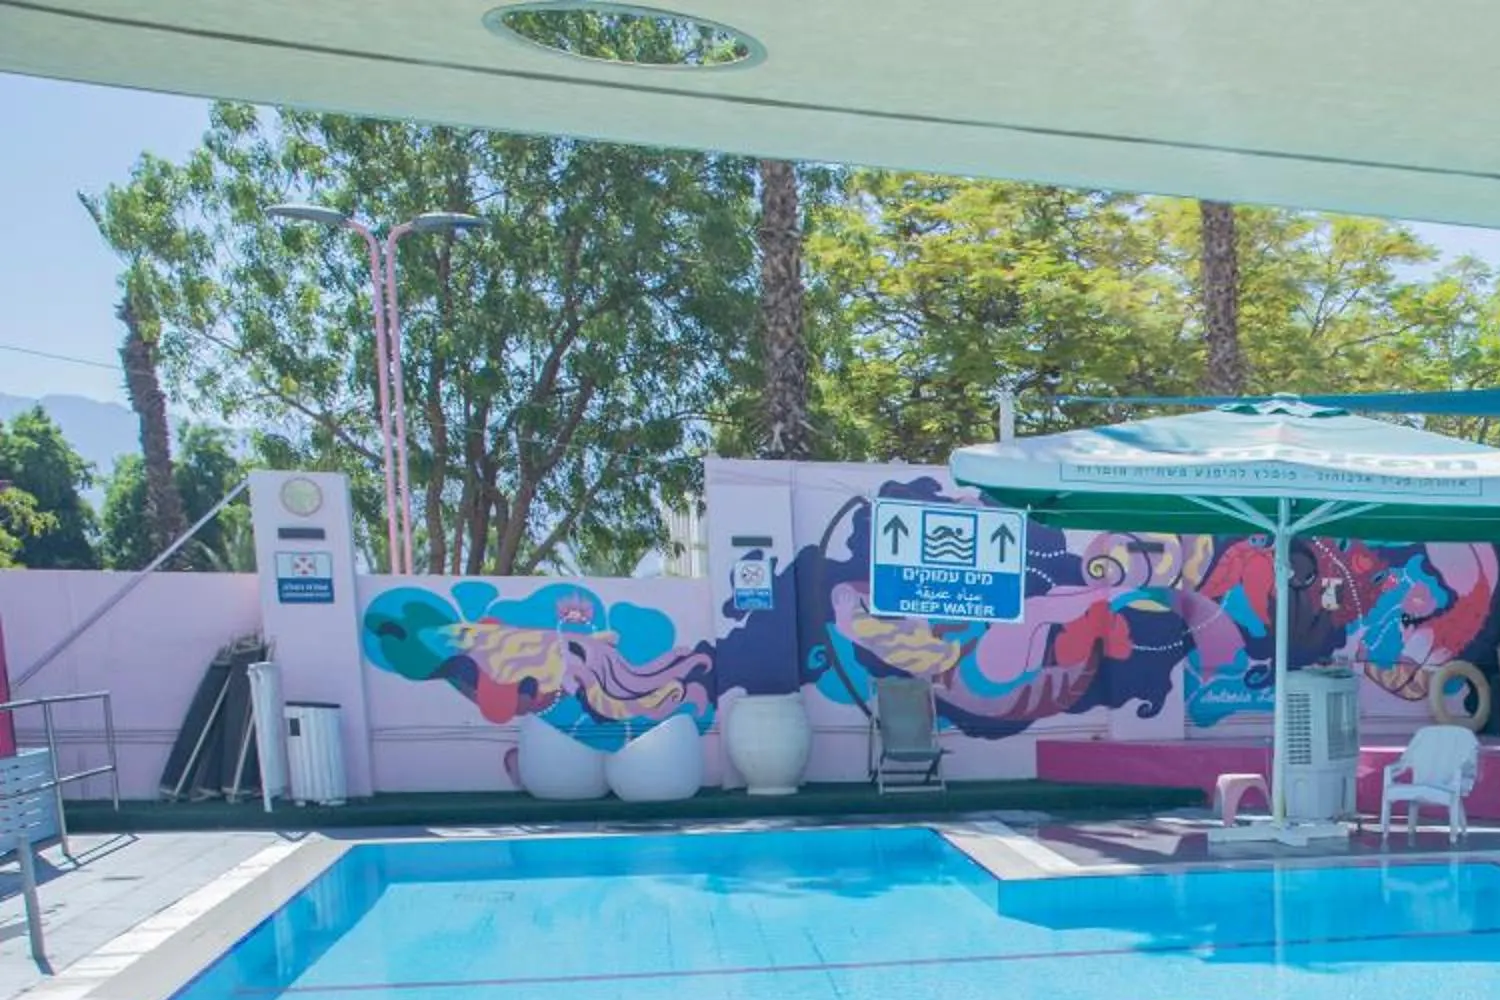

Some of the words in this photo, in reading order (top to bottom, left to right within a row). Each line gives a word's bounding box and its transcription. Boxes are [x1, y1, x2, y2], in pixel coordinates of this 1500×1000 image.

[903, 567, 959, 584] עמוקים
[965, 572, 993, 585] מים
[899, 599, 940, 613] DEEP
[943, 602, 996, 617] WATER
